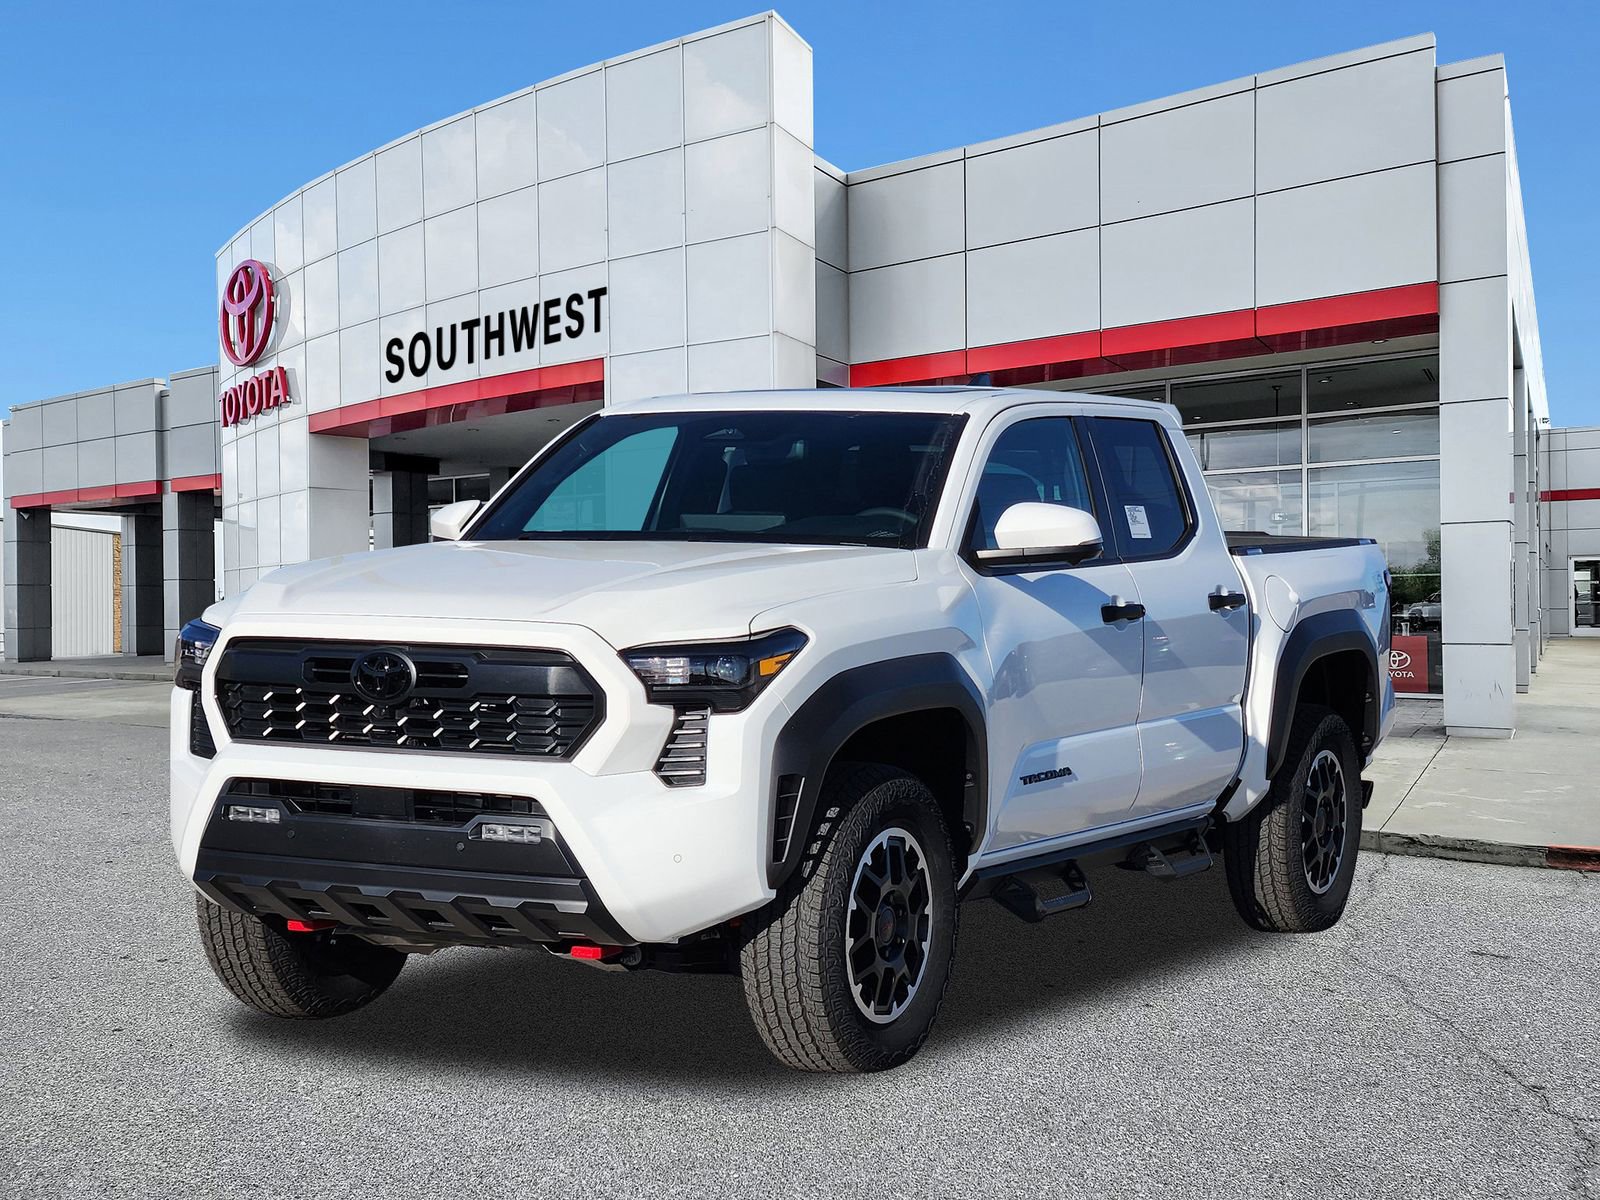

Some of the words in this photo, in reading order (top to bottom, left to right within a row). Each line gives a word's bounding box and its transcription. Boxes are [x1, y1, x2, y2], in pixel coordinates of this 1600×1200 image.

[385, 287, 608, 383] SOUTHWEST
[217, 366, 291, 427] TOYOTA
[1388, 670, 1415, 678] YOTA
[1019, 766, 1073, 786] TACOMA
